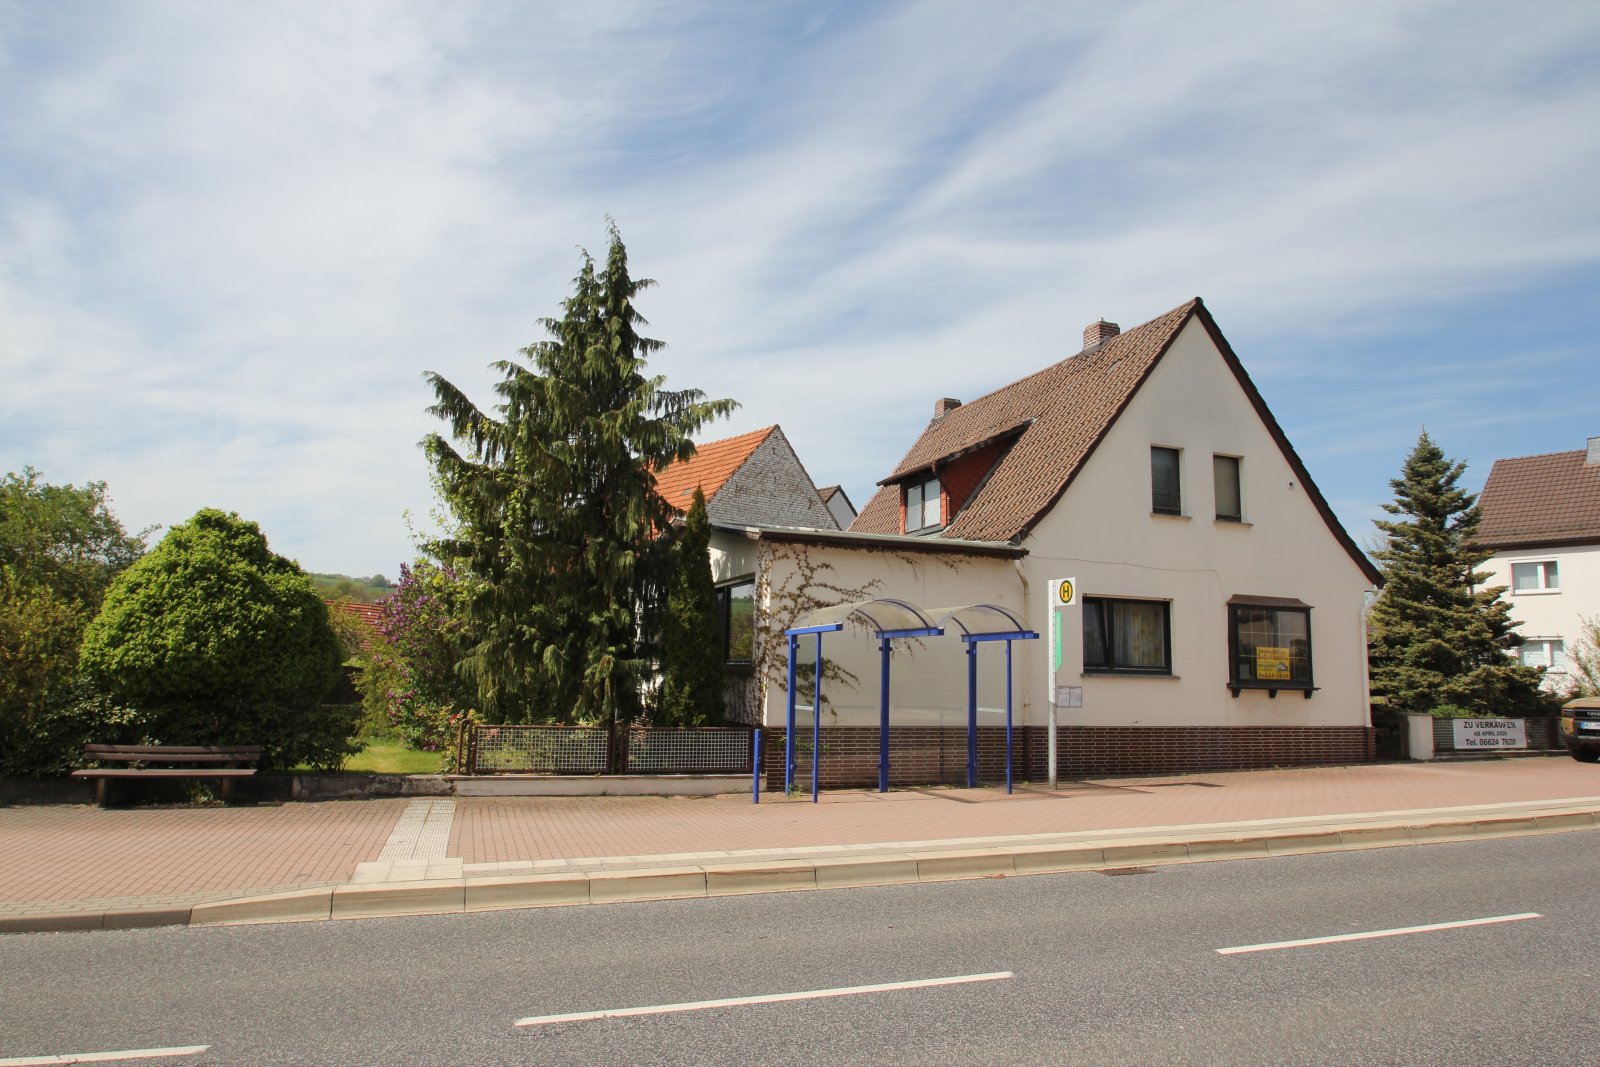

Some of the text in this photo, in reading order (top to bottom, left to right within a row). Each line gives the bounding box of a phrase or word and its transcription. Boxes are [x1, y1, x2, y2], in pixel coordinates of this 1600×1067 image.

[1062, 584, 1070, 598] H
[1463, 721, 1516, 729] ZU VERKAUFEN
[1465, 738, 1478, 746] Tel.
[1479, 738, 1499, 746] 06624
